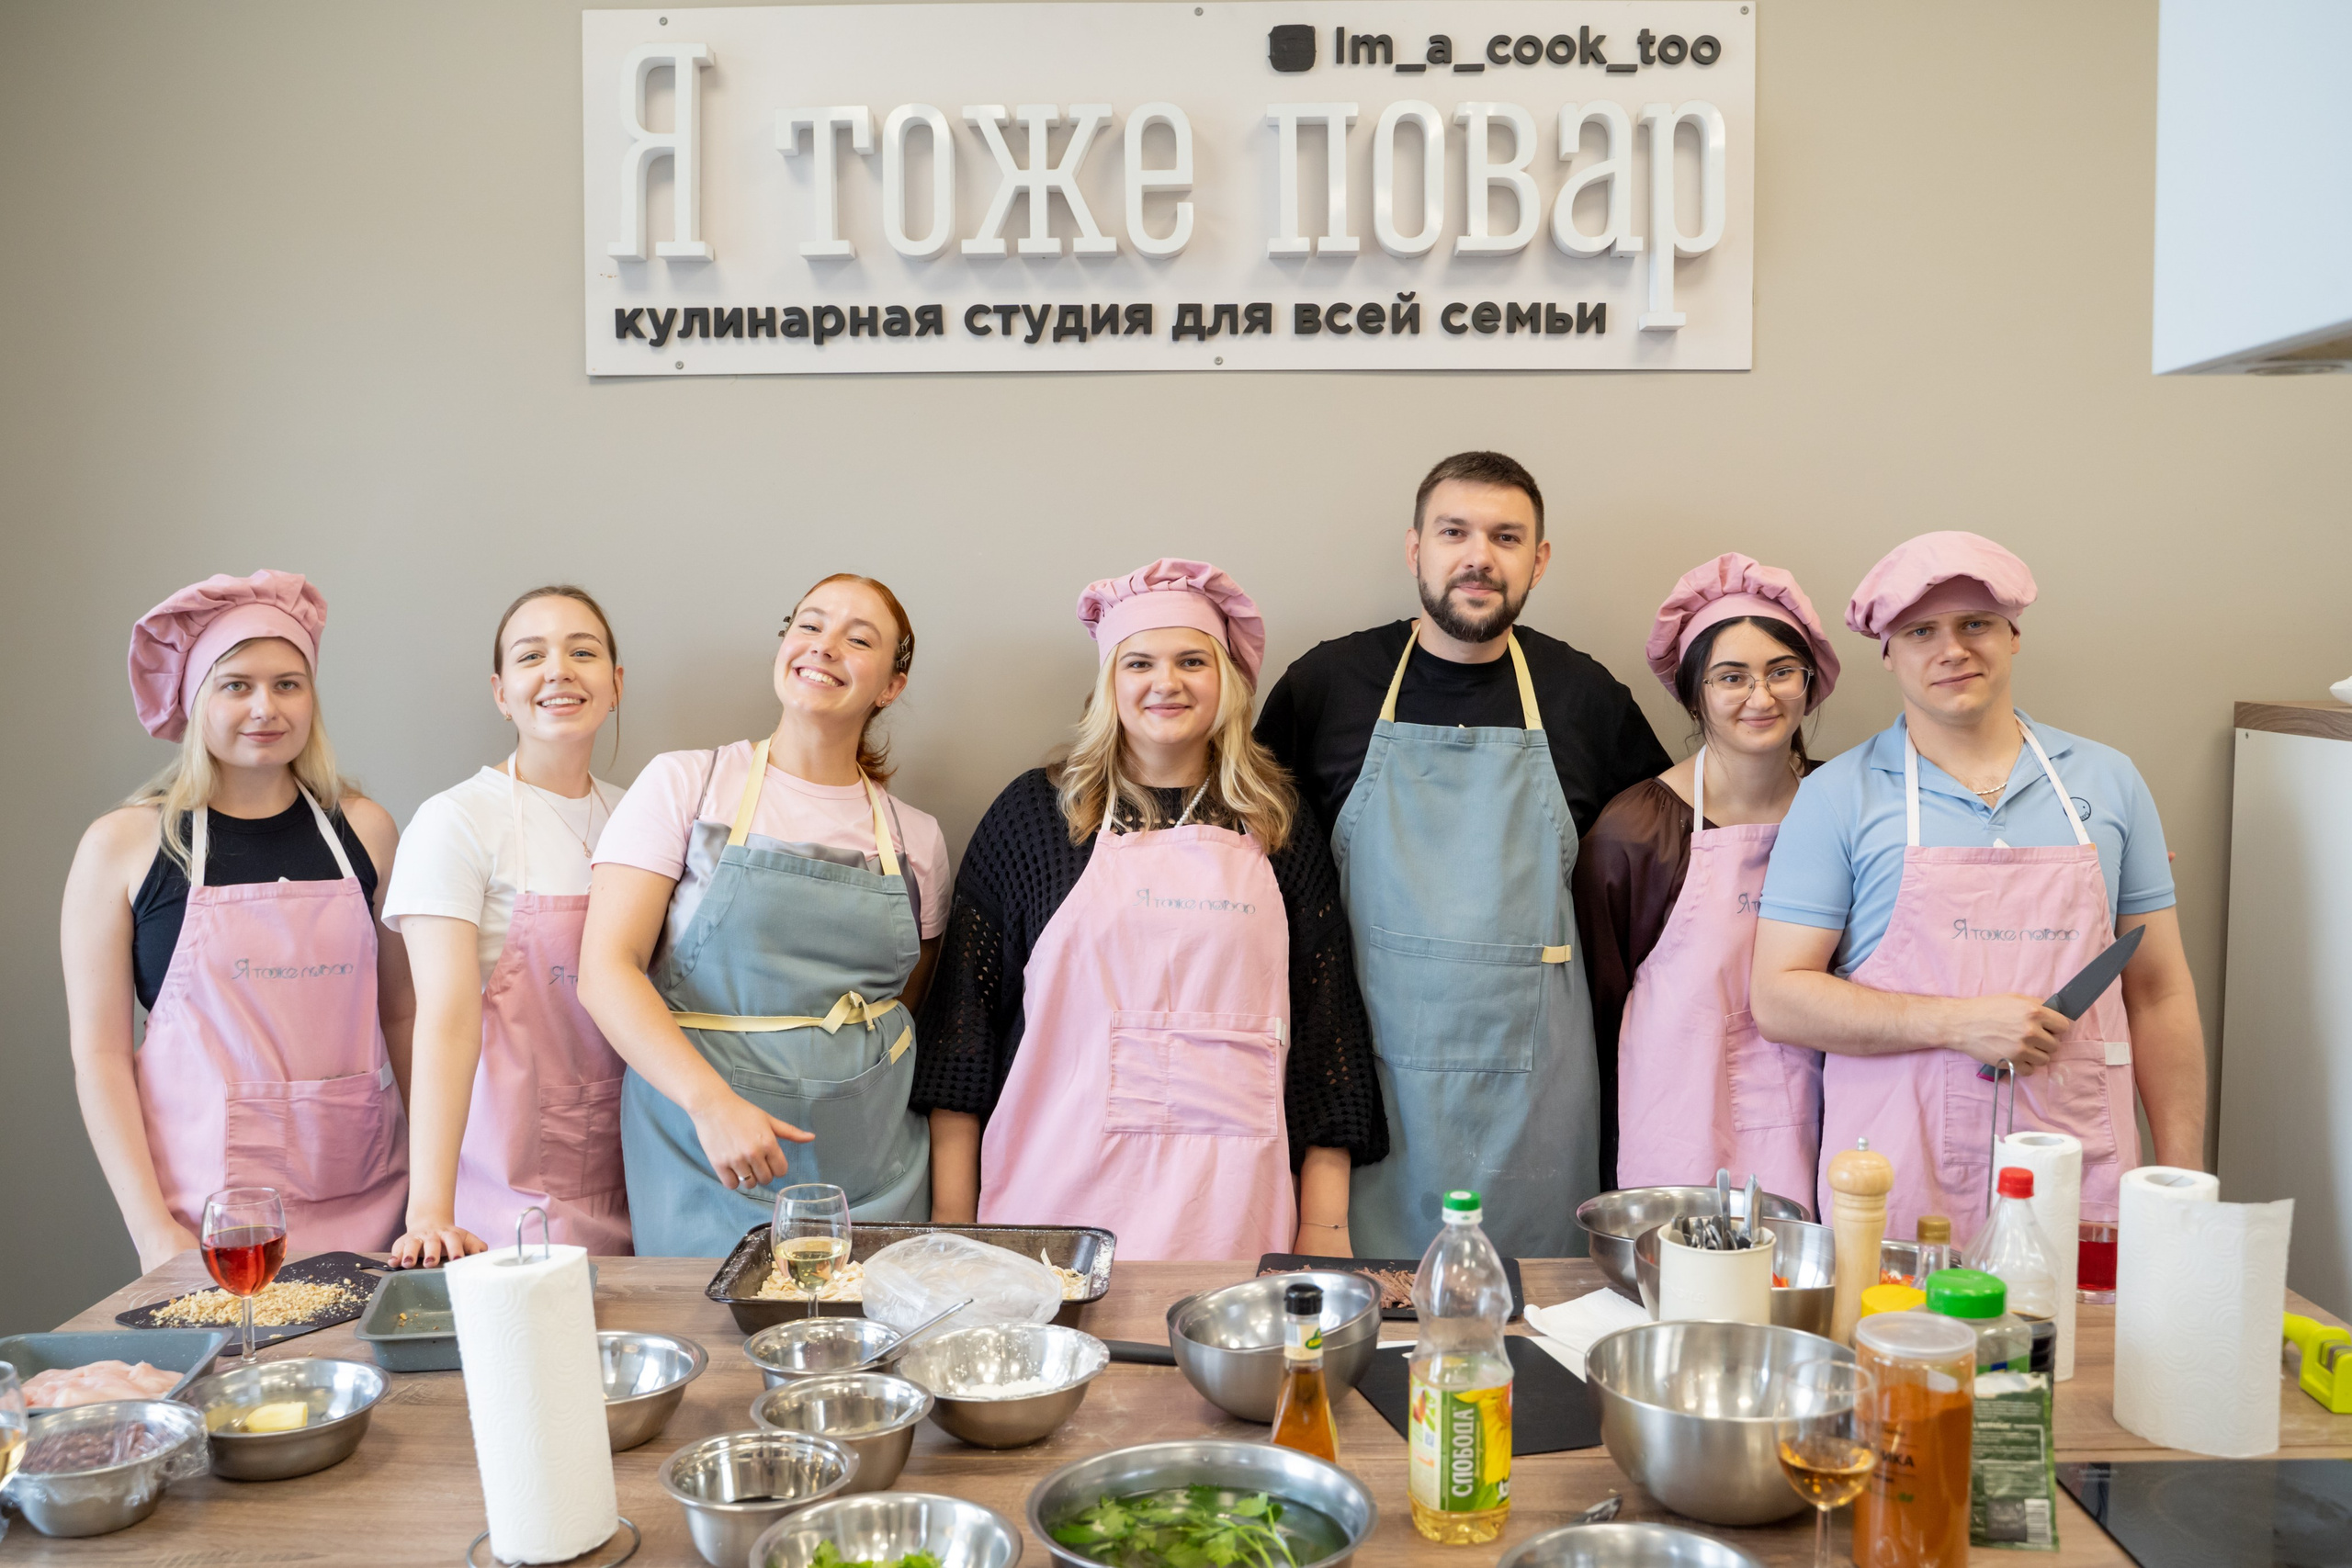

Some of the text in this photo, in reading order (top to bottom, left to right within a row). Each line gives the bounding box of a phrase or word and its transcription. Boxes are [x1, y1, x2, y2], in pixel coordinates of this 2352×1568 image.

[607, 42, 1726, 332] Я тоже повар
[615, 291, 1607, 347] кулинарная студия для всей семьи
[1132, 888, 1149, 908] Я
[1736, 892, 1751, 914] Я
[1951, 918, 1968, 940] Я
[231, 958, 250, 980] Я
[548, 965, 565, 986] Я
[1451, 1407, 1475, 1498] СЛОБОДА
